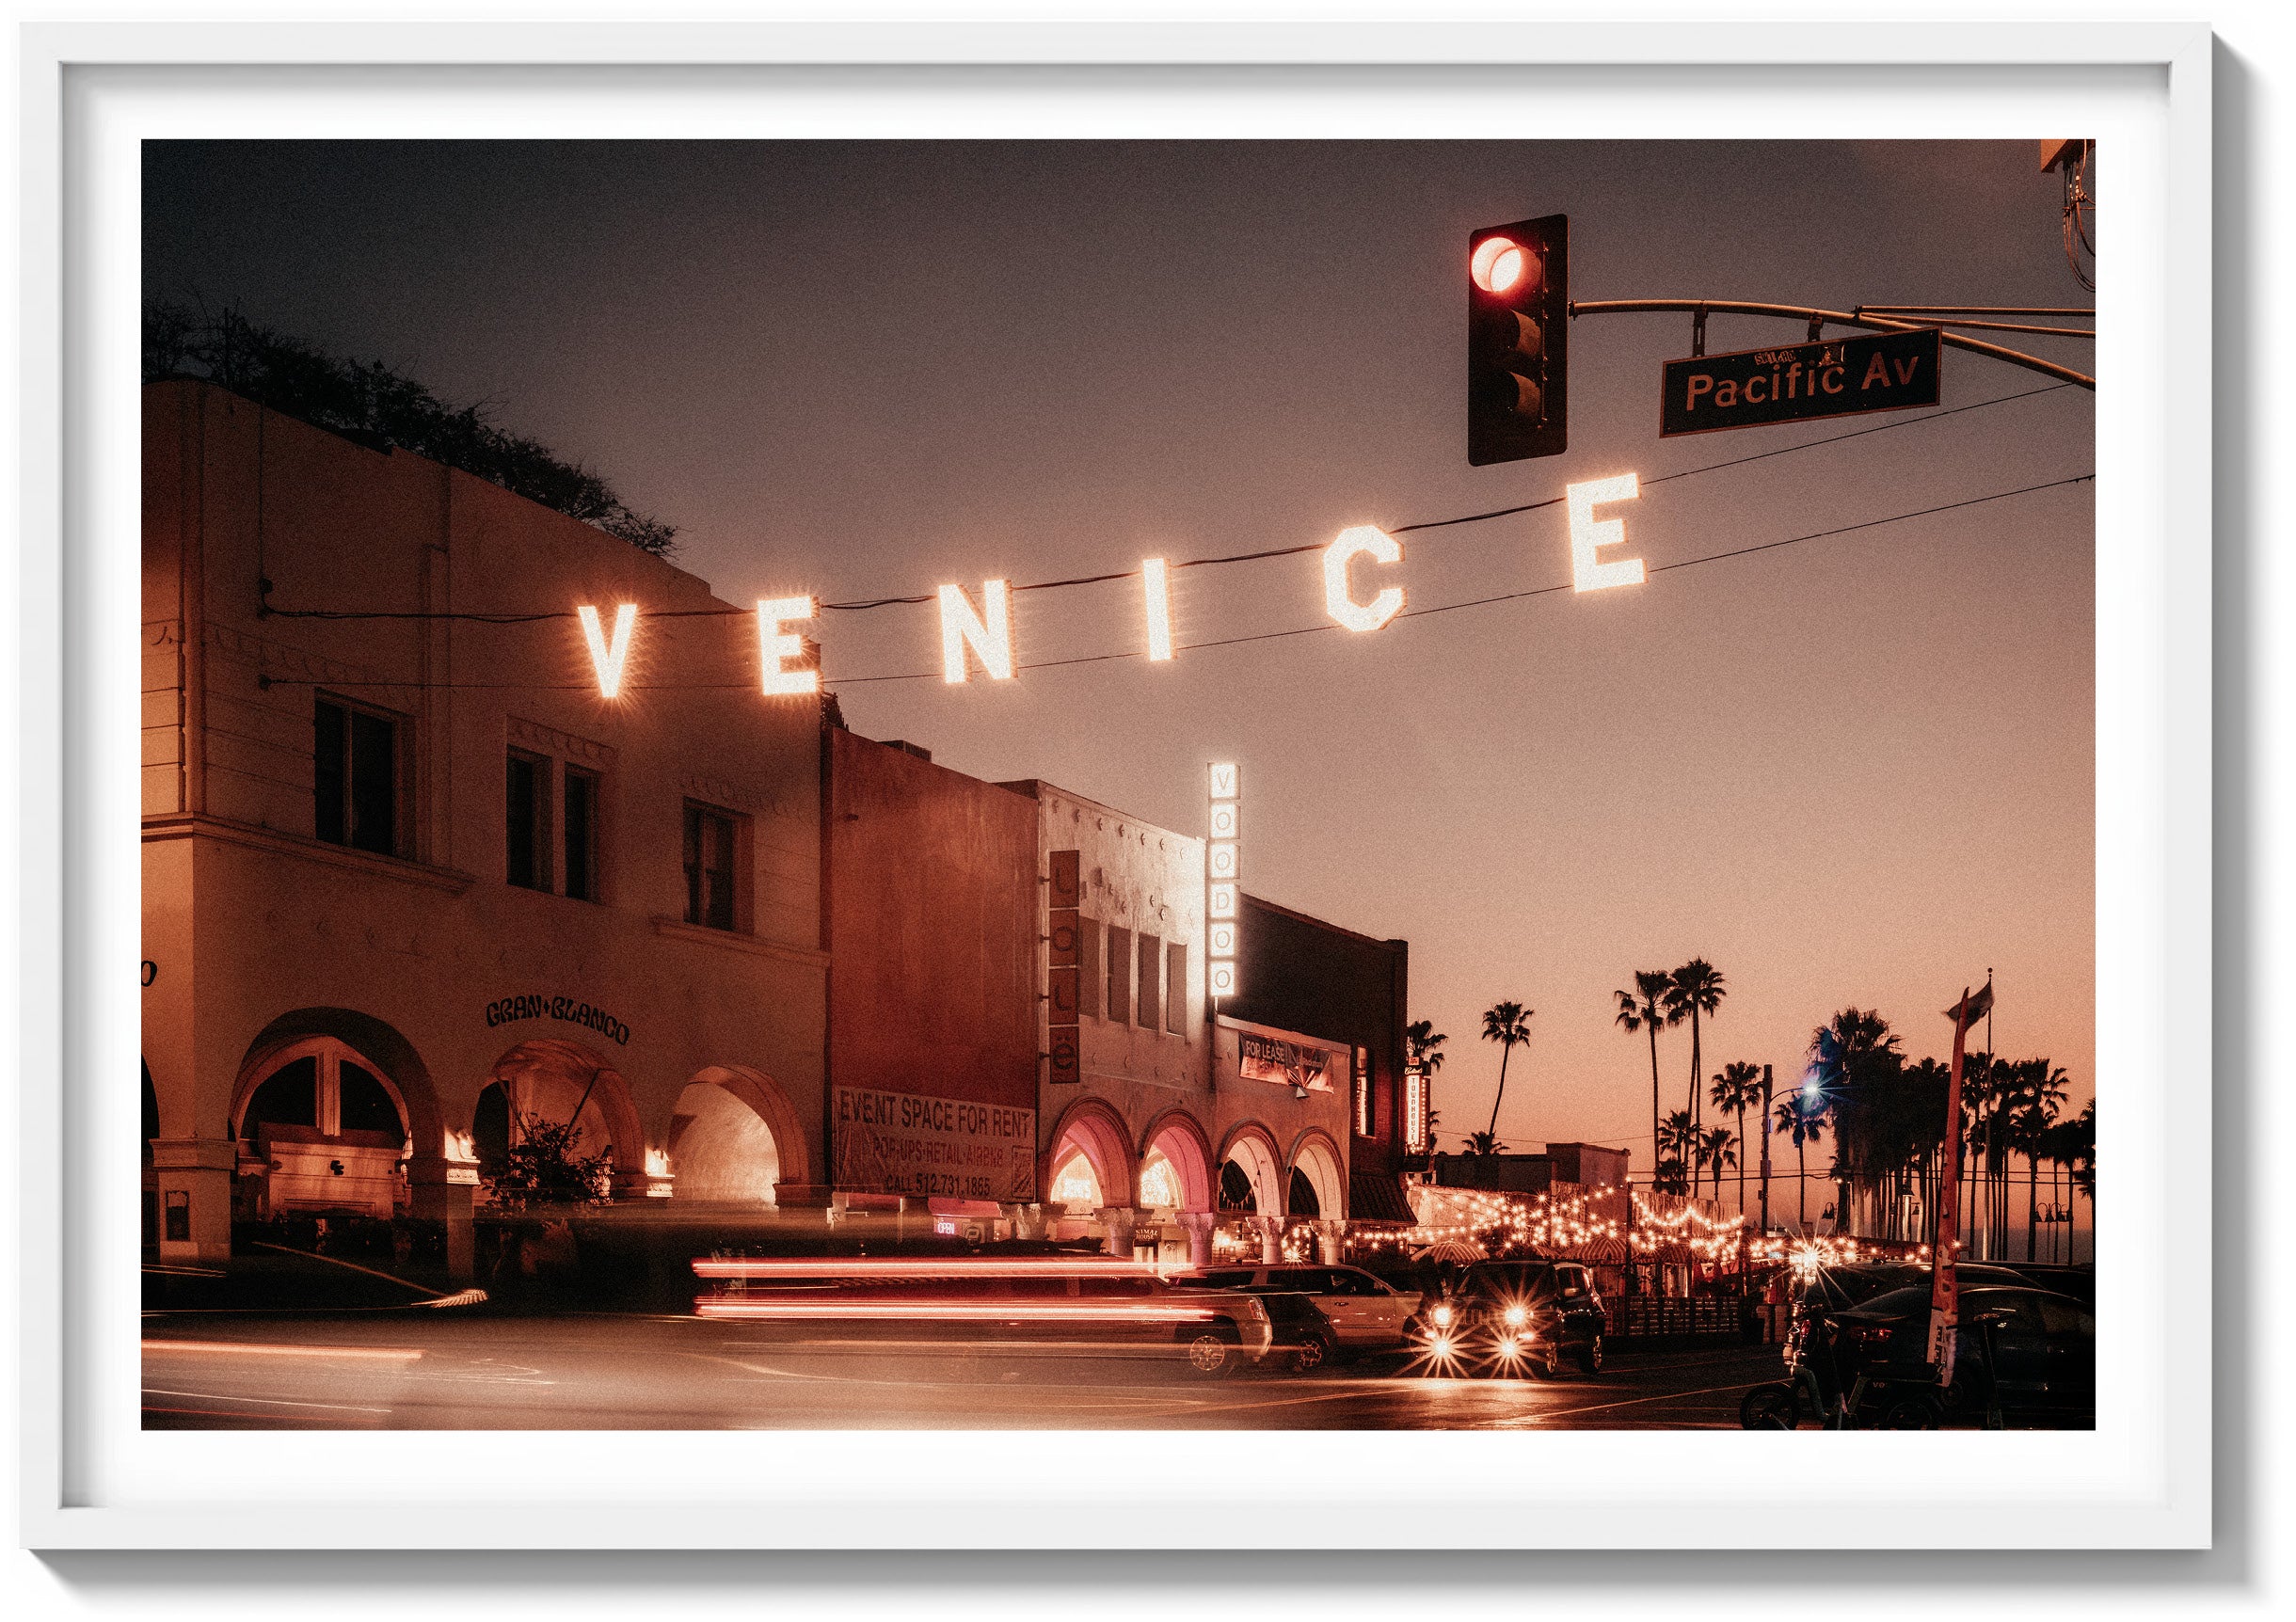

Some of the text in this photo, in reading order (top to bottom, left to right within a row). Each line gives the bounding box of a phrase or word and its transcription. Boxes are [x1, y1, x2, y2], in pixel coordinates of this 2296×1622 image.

[1686, 351, 1920, 411] Pacific Av
[577, 472, 1648, 698] VENICE
[1215, 771, 1231, 988] VOODOO
[486, 994, 630, 1045] GRAN BLANCO
[1246, 1040, 1261, 1057] FOR
[1262, 1043, 1285, 1062] LEASE
[839, 1089, 1032, 1138] EVENT SPACE FOR RENT
[885, 1174, 913, 1192] CALL
